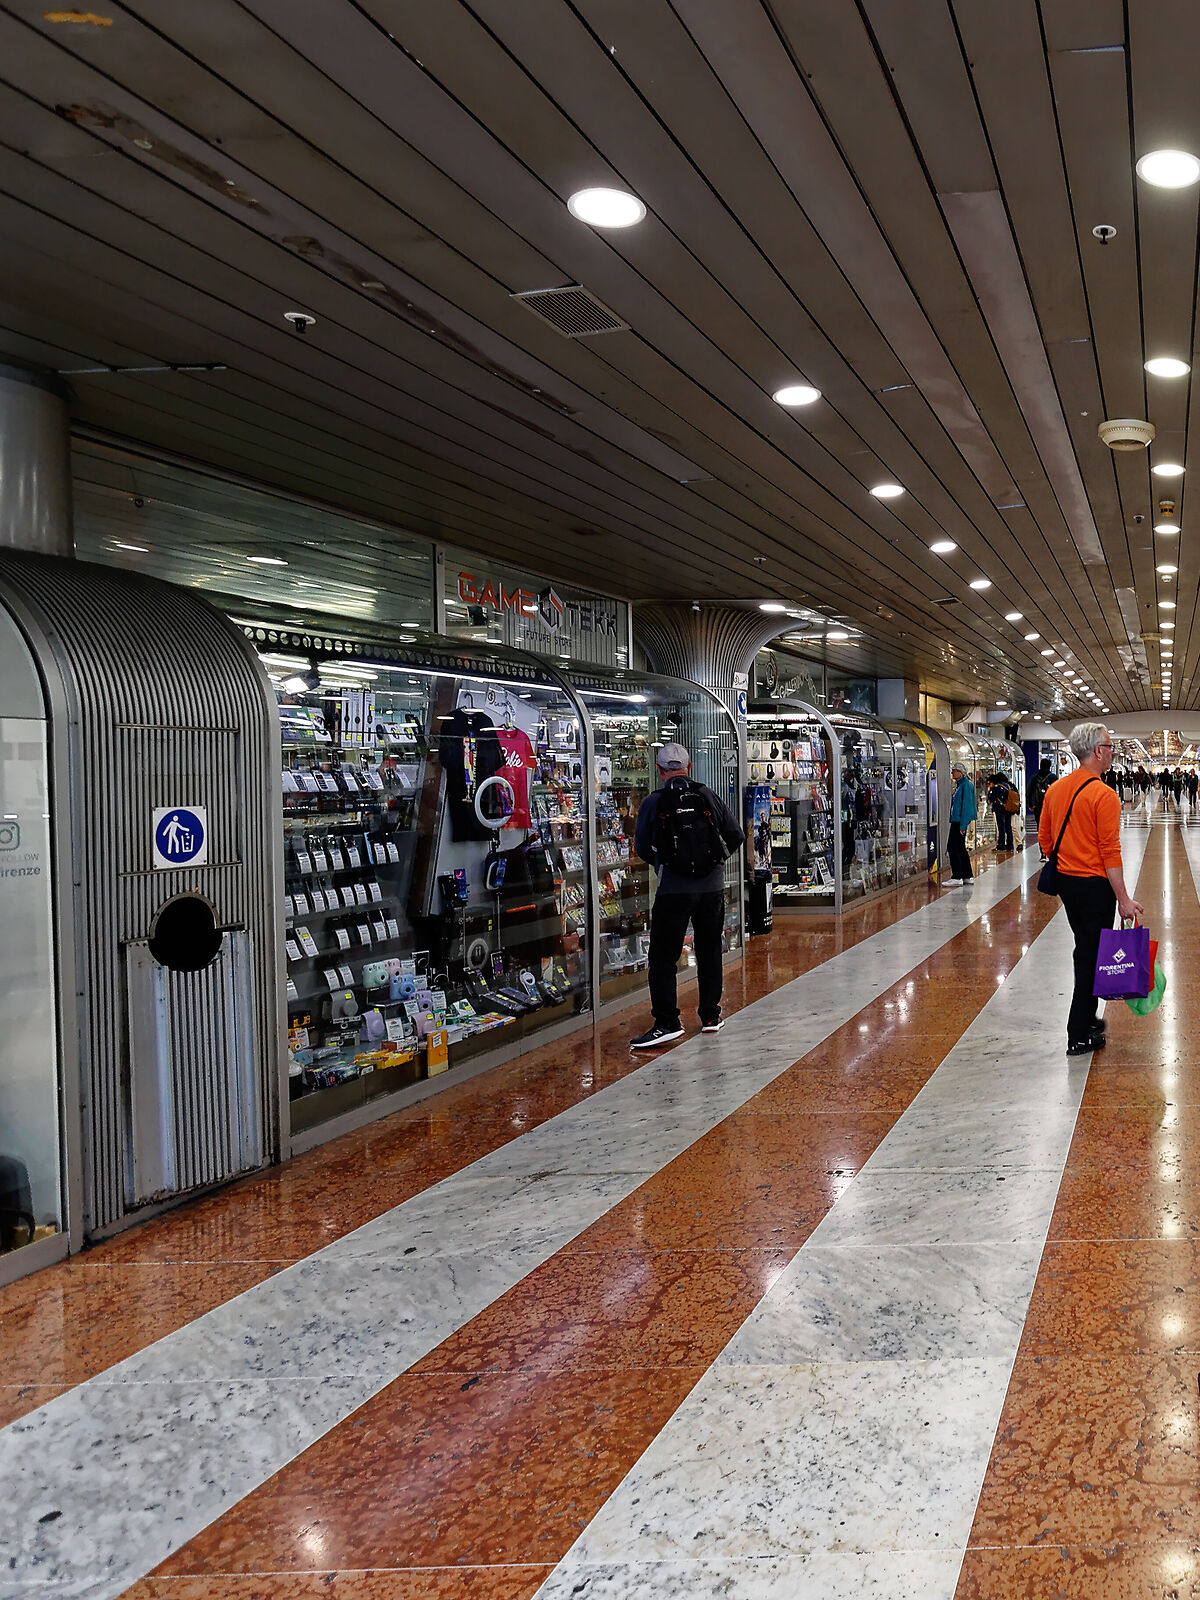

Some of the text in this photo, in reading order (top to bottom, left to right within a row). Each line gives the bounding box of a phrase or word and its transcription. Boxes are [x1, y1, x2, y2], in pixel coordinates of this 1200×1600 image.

[457, 571, 535, 618] GAME
[525, 630, 573, 648] FUTURE STORE
[1098, 962, 1135, 972] FIORENTINA
